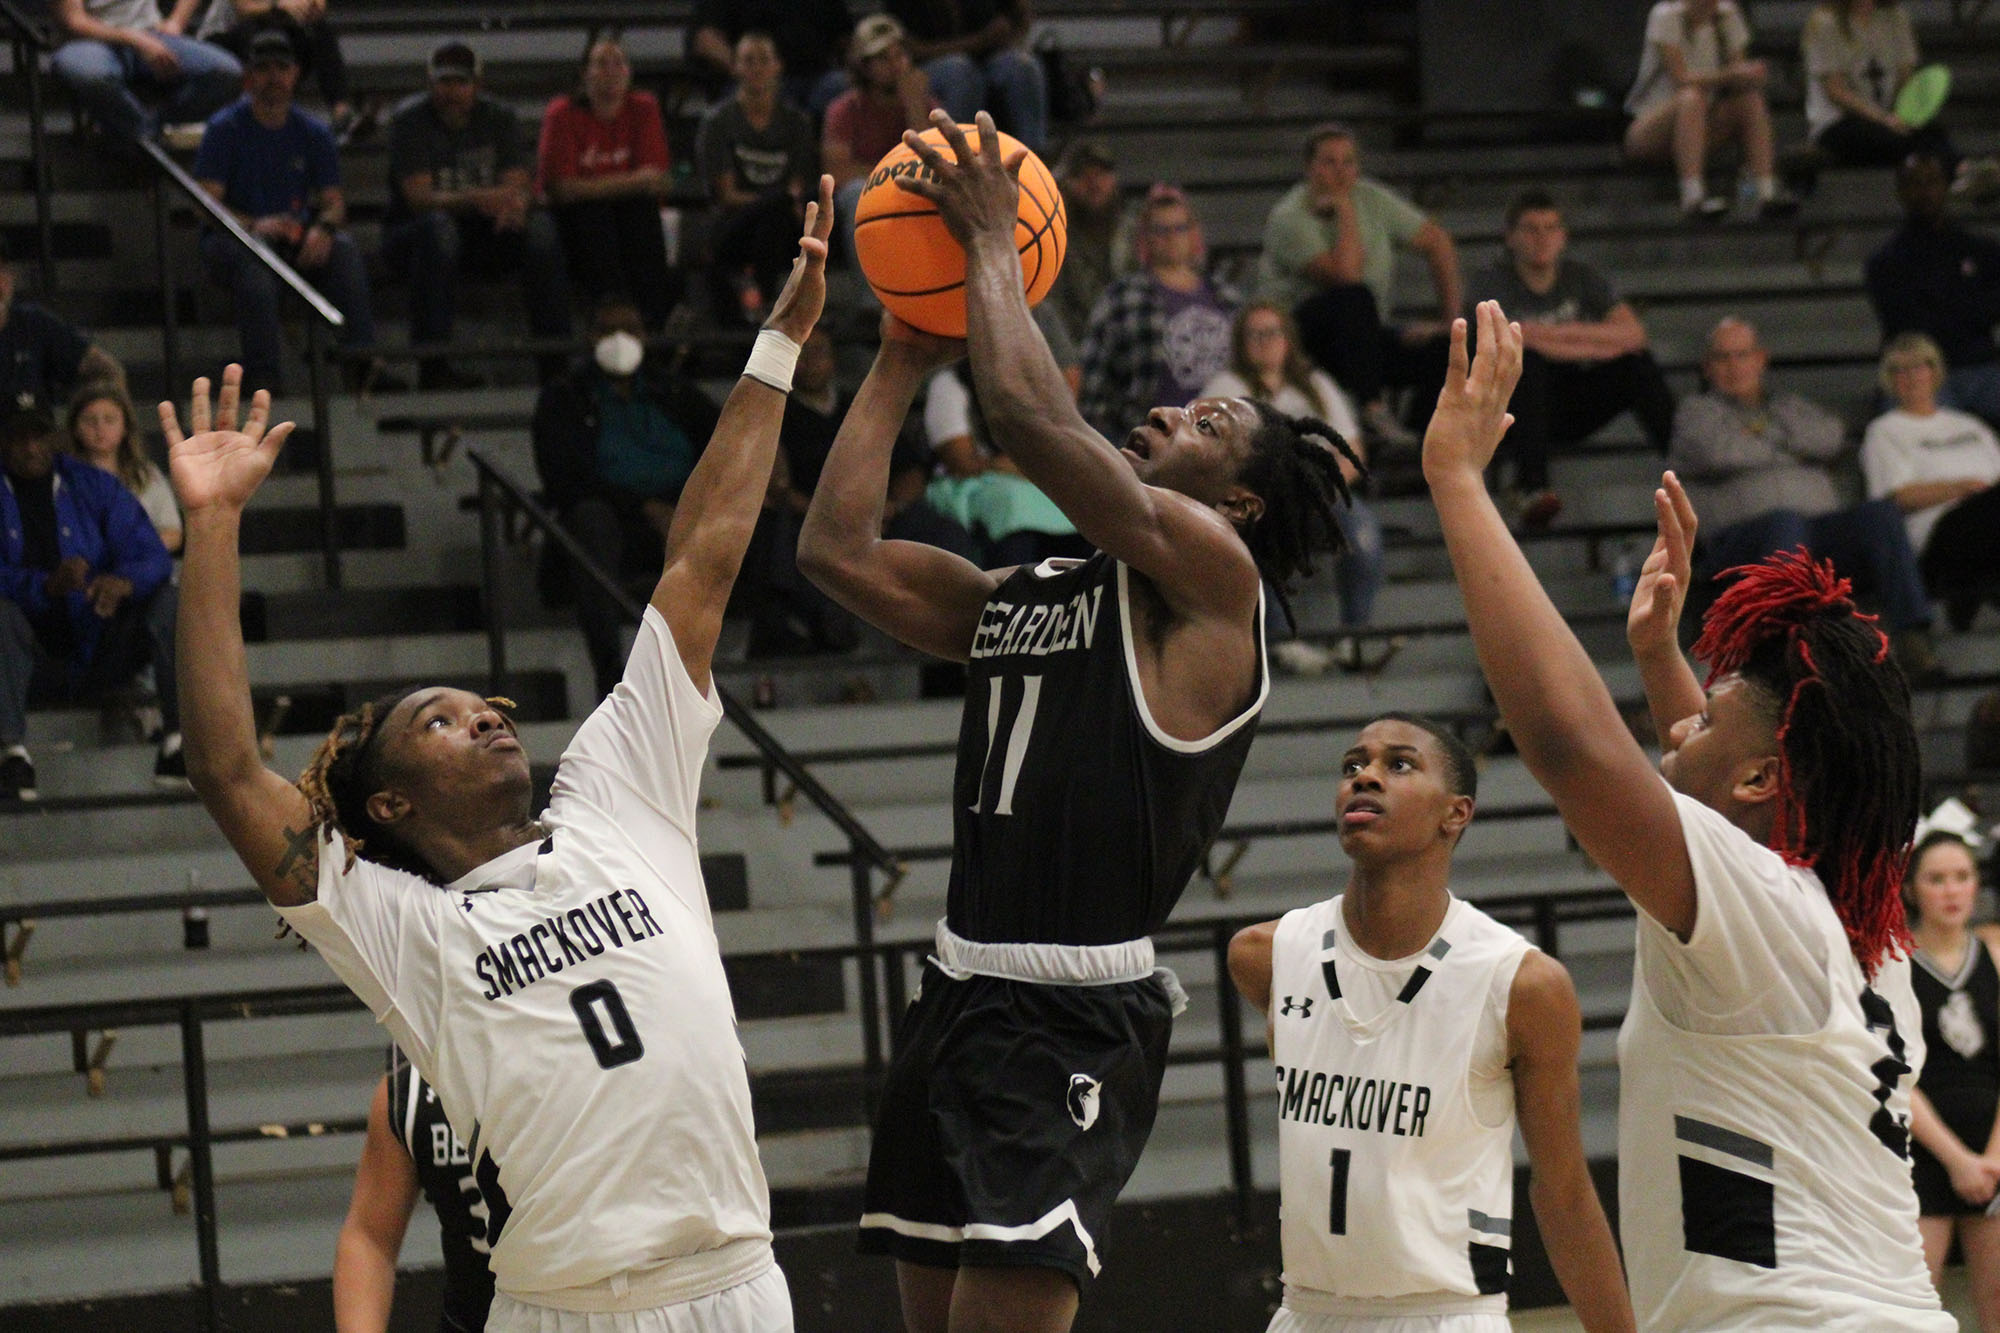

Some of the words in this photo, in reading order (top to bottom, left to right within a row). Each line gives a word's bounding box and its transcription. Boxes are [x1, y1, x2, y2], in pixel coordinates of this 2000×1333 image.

[968, 675, 1043, 816] 11
[475, 887, 664, 1001] SMACKOVER
[568, 978, 645, 1071] 0
[1328, 1147, 1351, 1236] 1
